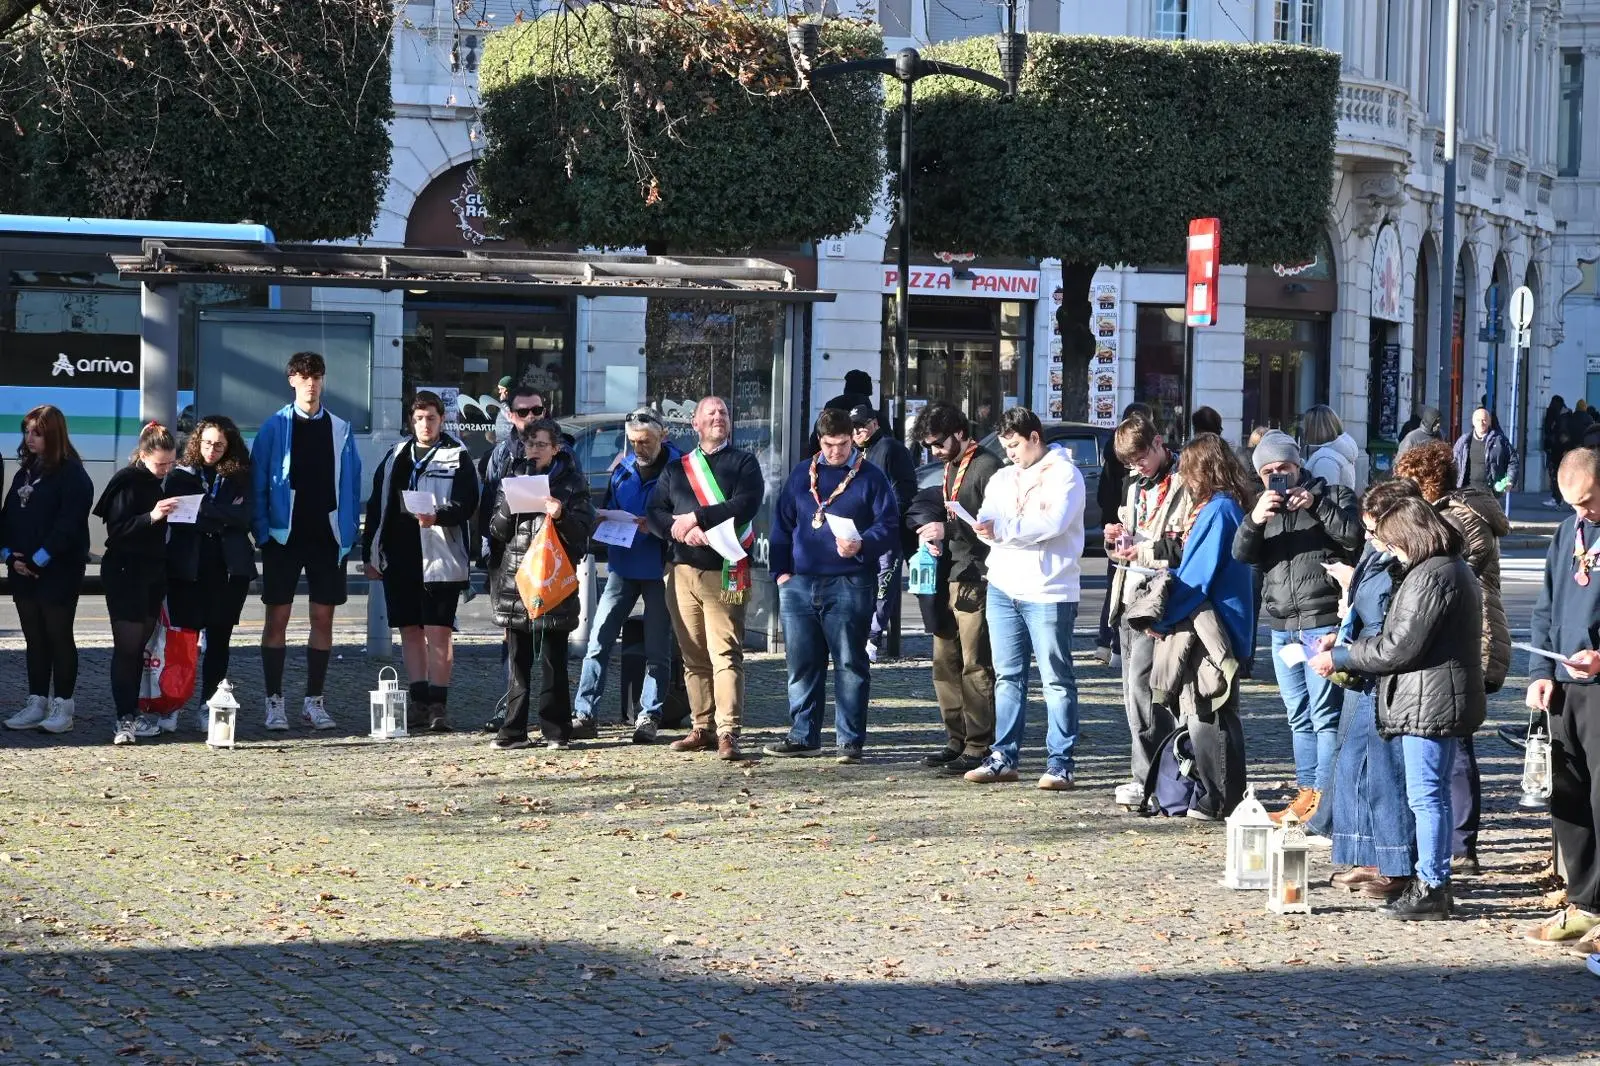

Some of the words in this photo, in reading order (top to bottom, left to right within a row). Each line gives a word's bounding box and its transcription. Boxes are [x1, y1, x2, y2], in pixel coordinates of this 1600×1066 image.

[465, 194, 485, 205] GU
[465, 205, 488, 217] RA
[885, 271, 951, 290] PZZA
[971, 275, 1037, 293] PANINI
[76, 356, 134, 374] arriva
